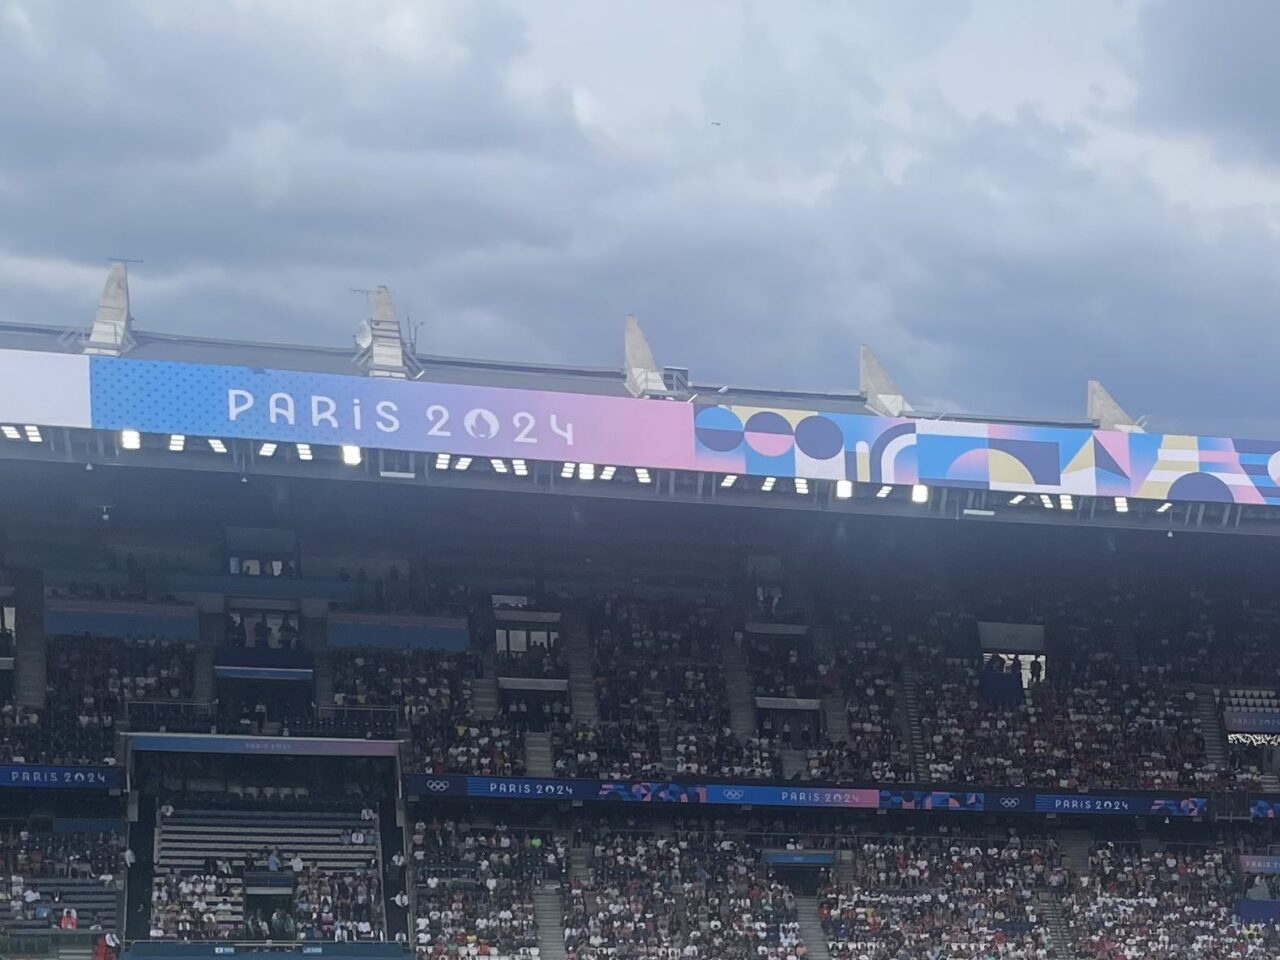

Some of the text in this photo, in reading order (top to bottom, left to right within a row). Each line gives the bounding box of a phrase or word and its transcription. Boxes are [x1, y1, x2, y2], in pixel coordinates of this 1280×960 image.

[426, 404, 575, 446] 2024
[12, 772, 105, 783] PARIS 2024
[490, 783, 573, 795] PARIS 2024
[782, 791, 860, 803] PARIS 2024
[1055, 799, 1128, 811] PARIS 2024
